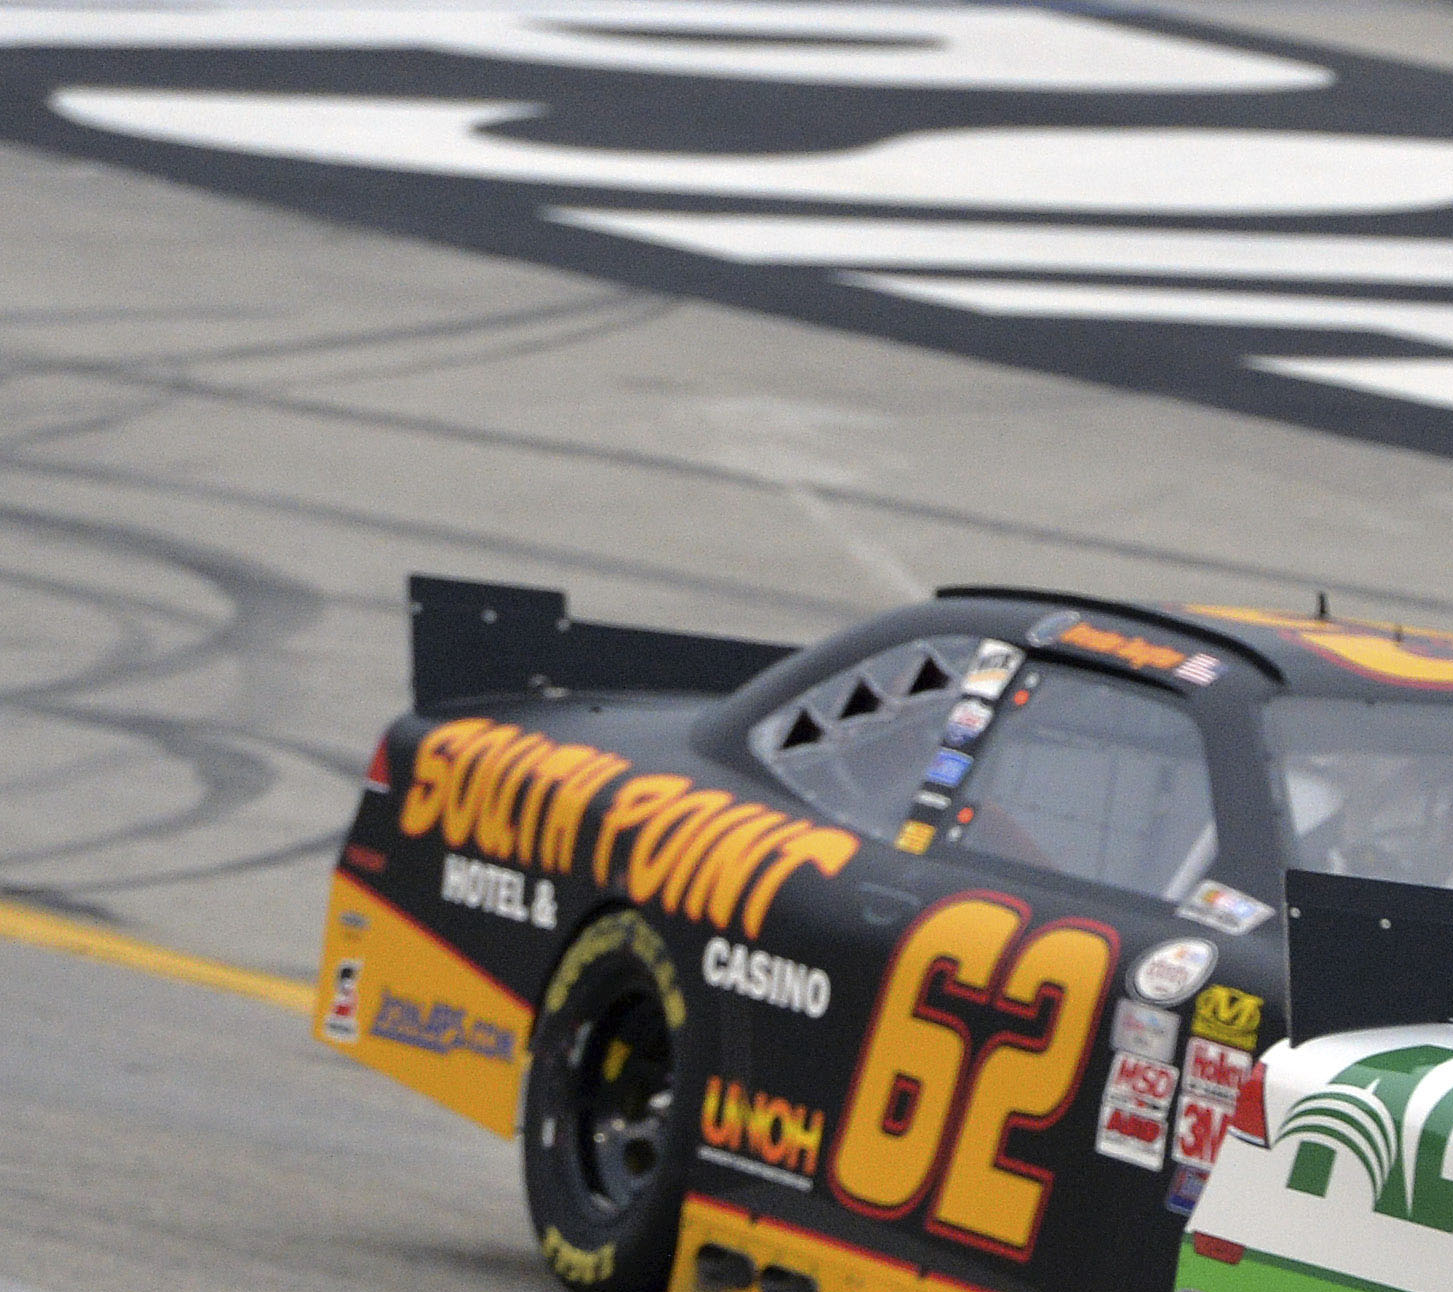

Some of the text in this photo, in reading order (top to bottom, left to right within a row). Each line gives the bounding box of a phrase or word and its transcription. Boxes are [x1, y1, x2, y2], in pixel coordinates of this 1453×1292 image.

[402, 717, 860, 939] SOUTH POINT
[441, 853, 528, 921] HOTEL
[531, 879, 558, 931] &
[702, 937, 830, 1019] CASINO
[826, 890, 1121, 1253] 62
[703, 1077, 825, 1176] UNOH
